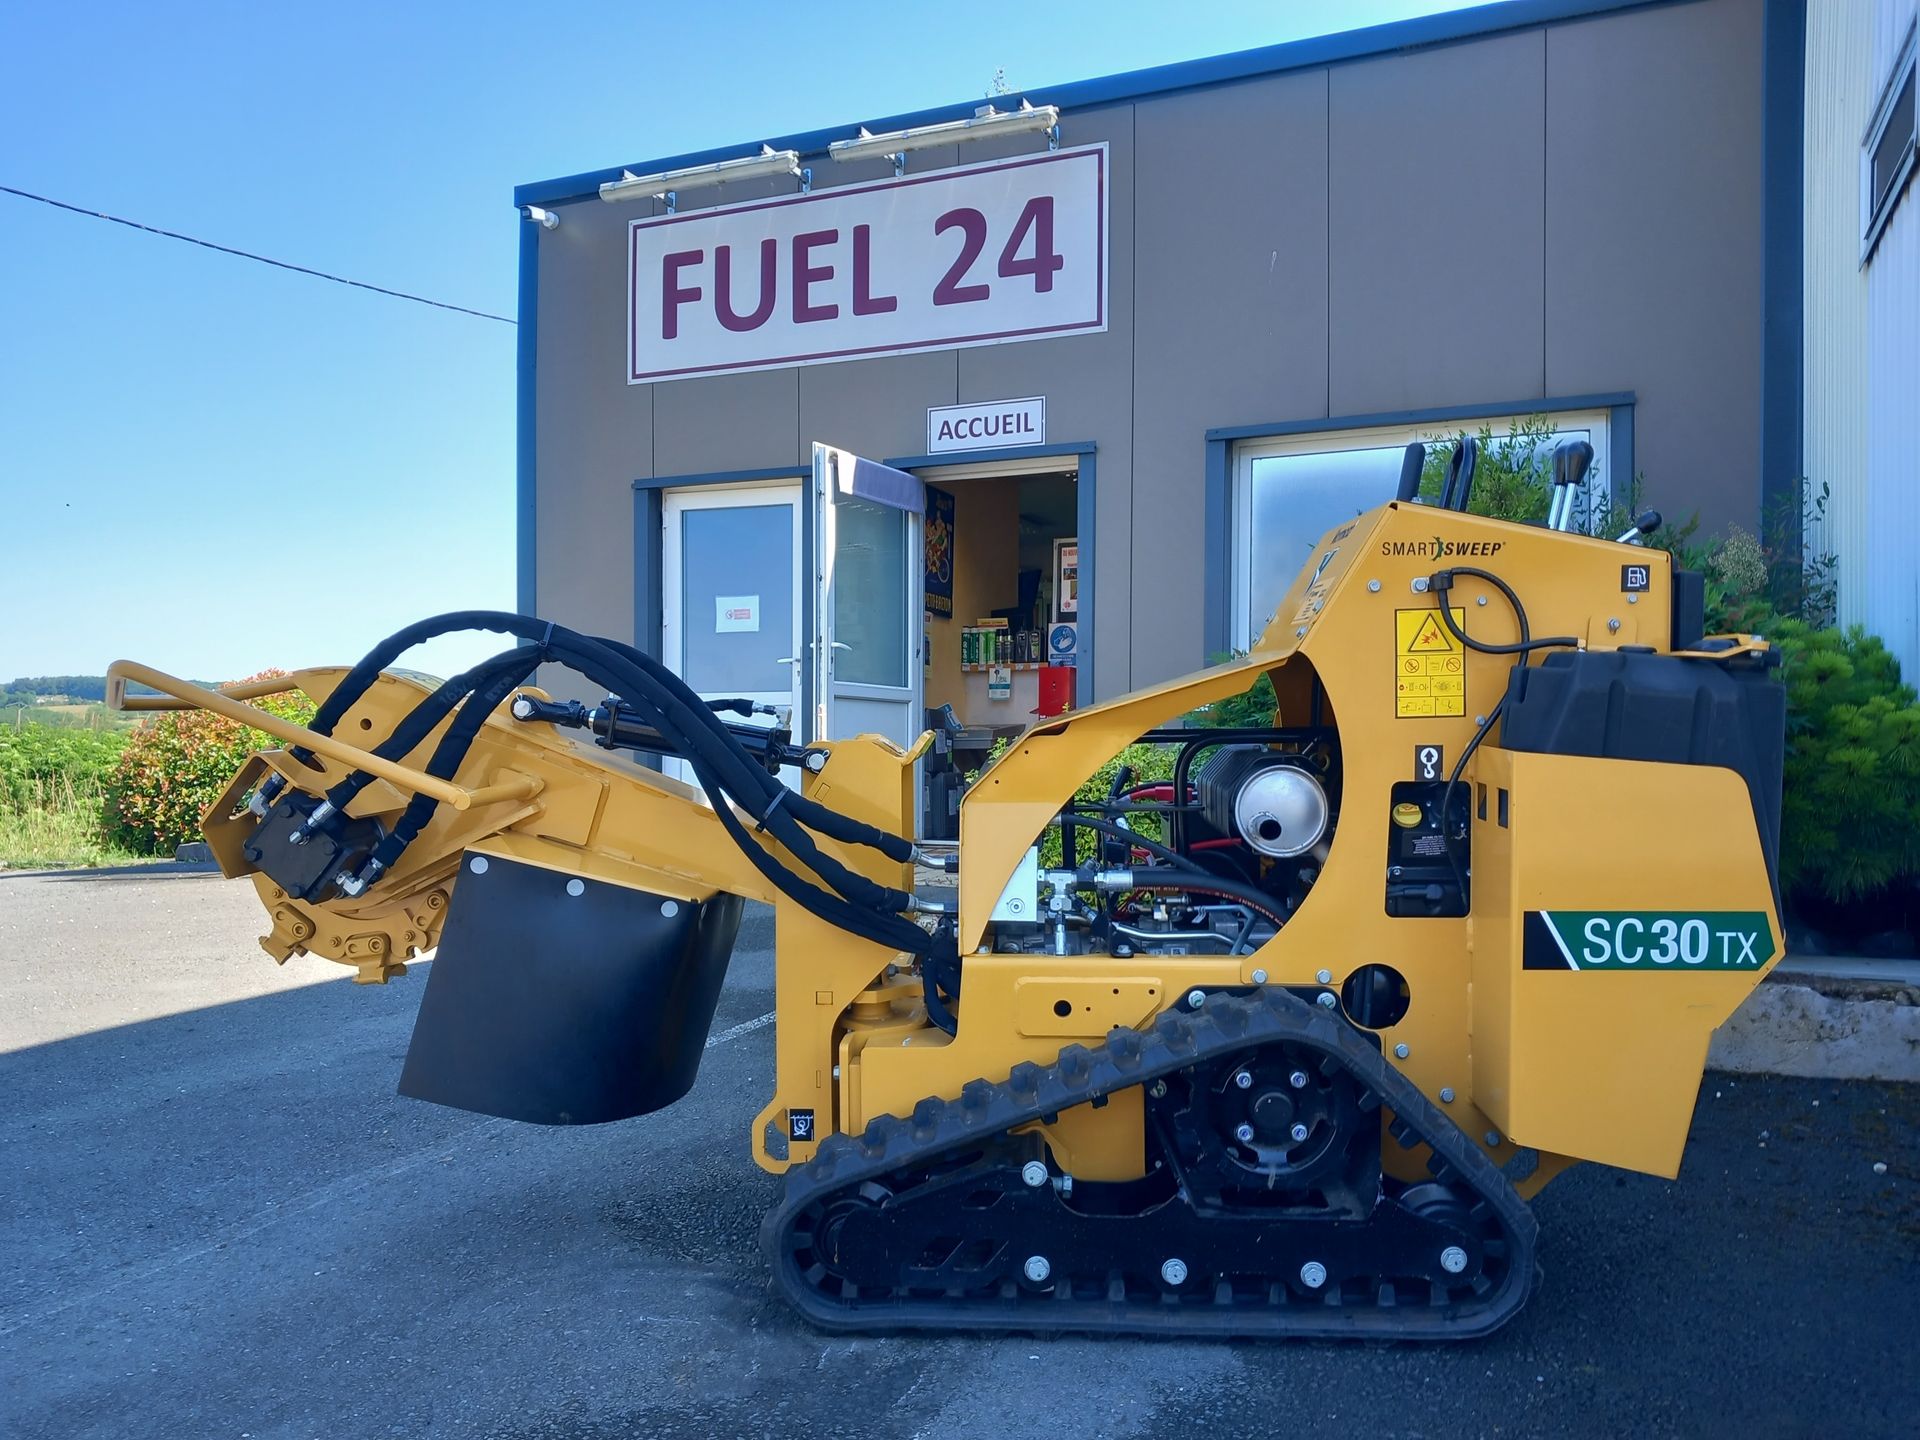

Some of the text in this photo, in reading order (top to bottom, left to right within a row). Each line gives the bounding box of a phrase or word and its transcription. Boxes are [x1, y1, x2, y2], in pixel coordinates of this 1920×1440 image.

[662, 196, 1064, 340] FUEL 24
[937, 411, 1035, 441] ACCUEIL
[1715, 931, 1758, 964] TX
